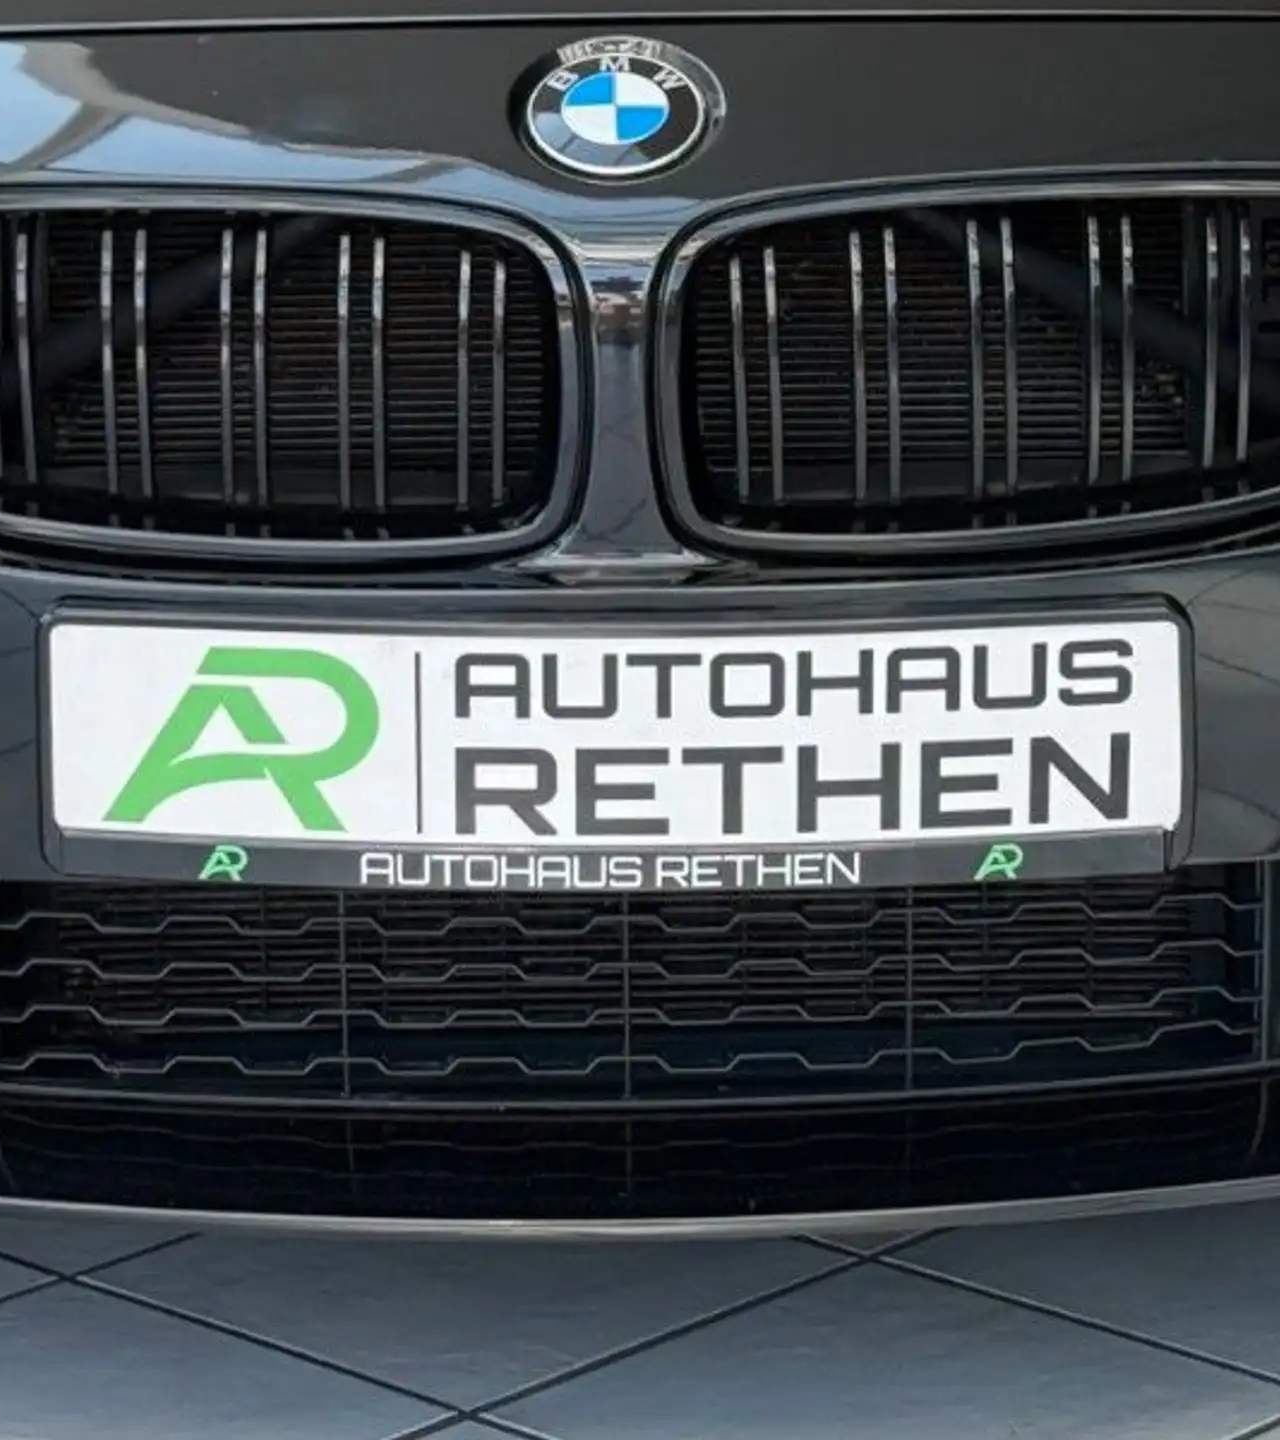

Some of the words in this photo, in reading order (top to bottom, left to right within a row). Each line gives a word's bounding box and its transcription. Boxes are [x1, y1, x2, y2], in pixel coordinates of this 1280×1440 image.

[546, 55, 687, 92] BMW
[454, 638, 1133, 719] AUTOHAUS
[454, 732, 1130, 836] RETHEN
[360, 852, 642, 888] AUTOHAUS
[656, 852, 860, 888] RETHEN
